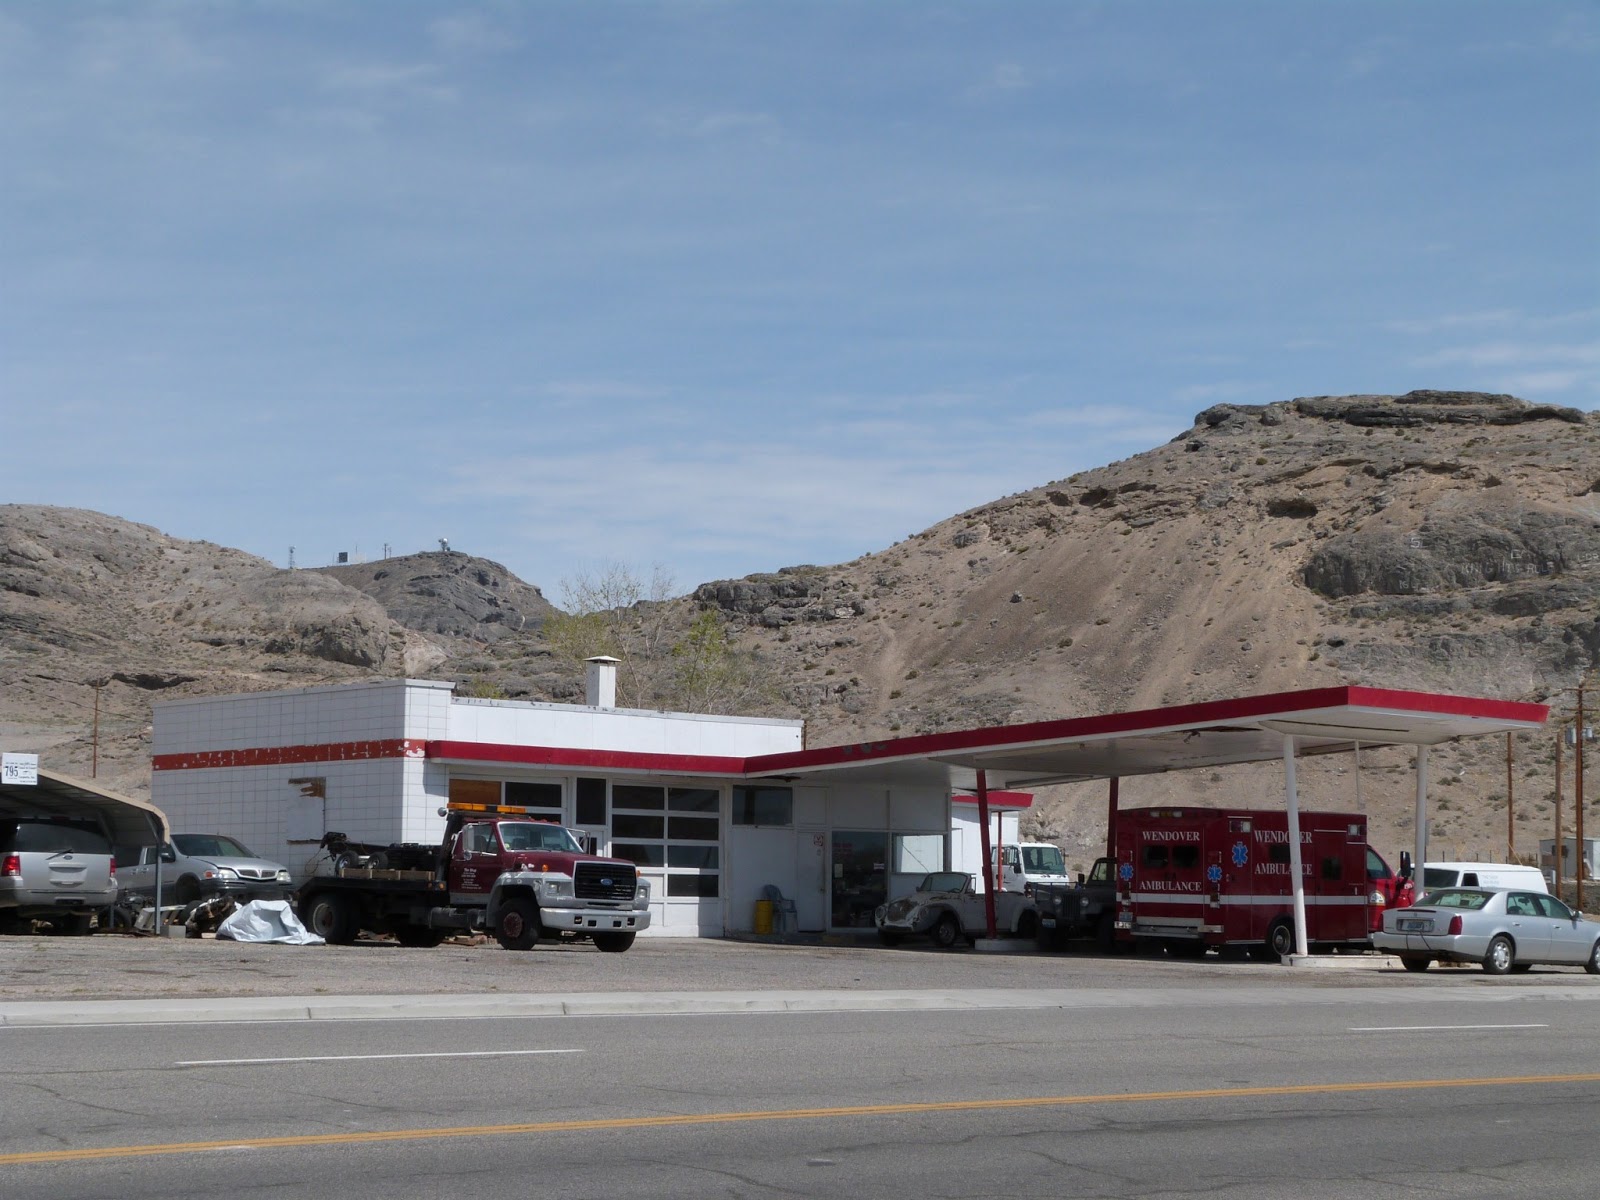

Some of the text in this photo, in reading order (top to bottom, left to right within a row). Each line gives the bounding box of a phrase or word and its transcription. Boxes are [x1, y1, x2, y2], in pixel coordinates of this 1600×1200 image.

[5, 765, 18, 777] 795
[1142, 831, 1200, 841] WENDOVER
[1254, 830, 1313, 843] WENDOER
[1139, 880, 1202, 891] AMBULANCE
